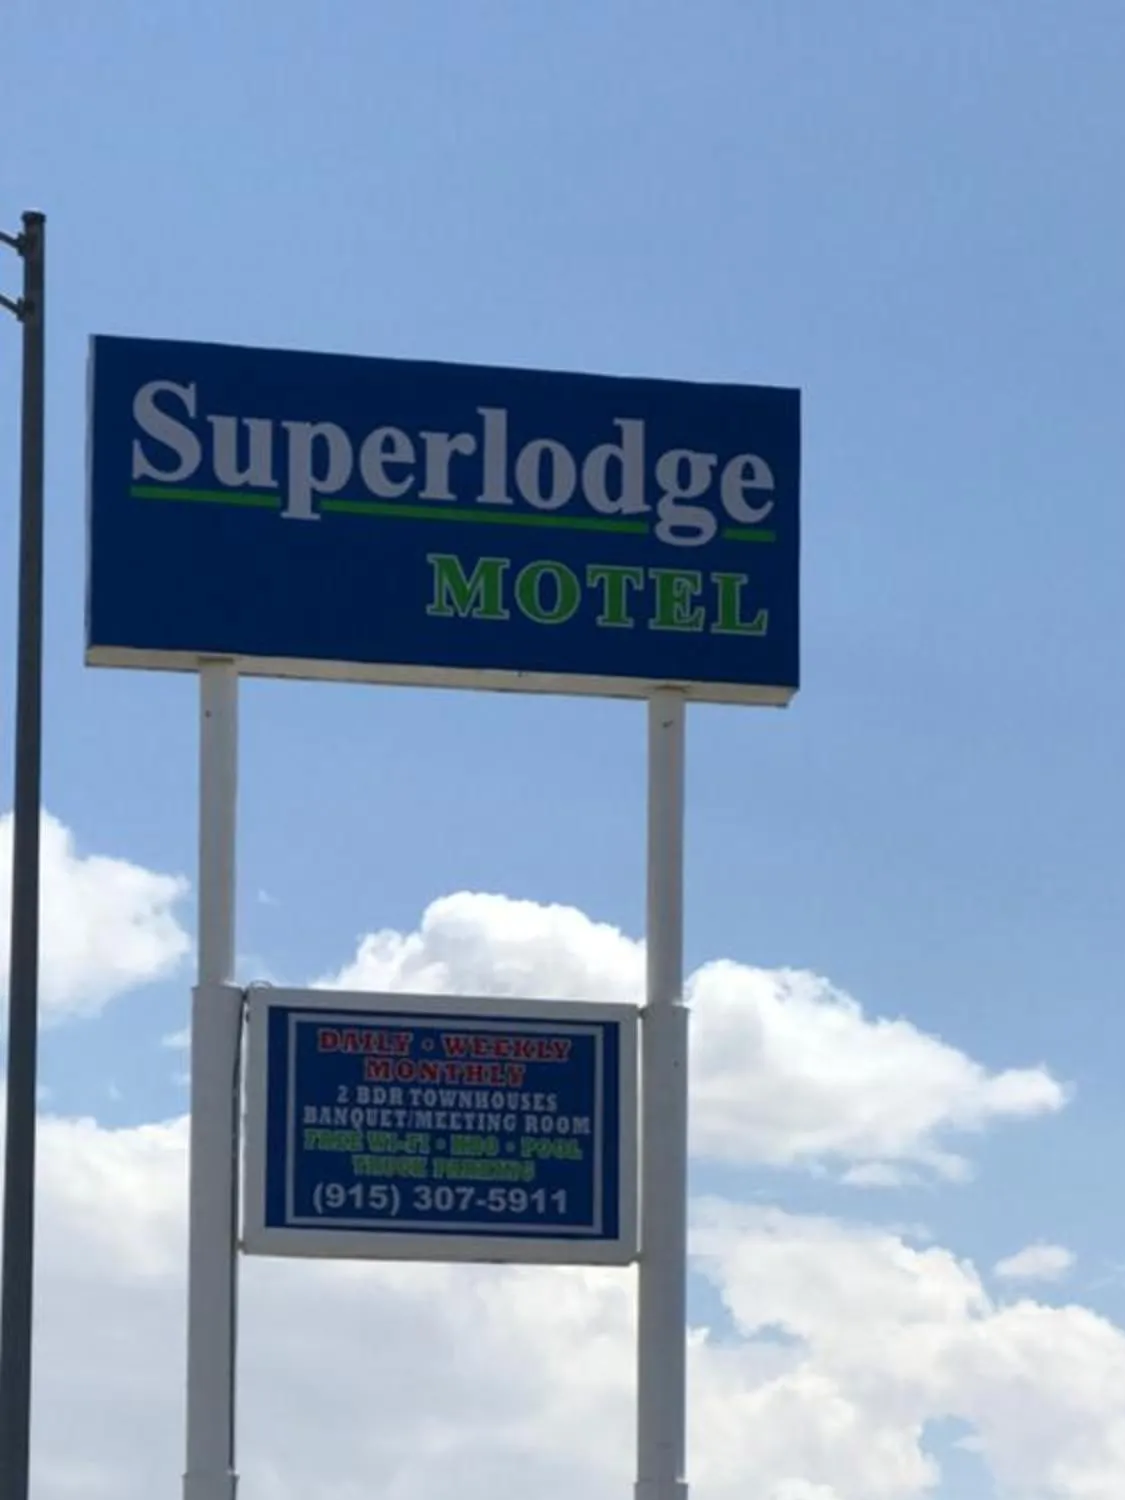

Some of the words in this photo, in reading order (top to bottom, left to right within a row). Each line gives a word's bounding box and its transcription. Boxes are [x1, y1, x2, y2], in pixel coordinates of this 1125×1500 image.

[131, 380, 776, 547] Superlodge
[426, 553, 770, 636] MOTEL
[317, 1027, 413, 1056] DAILY
[440, 1034, 572, 1063] WEEKLY
[364, 1056, 527, 1088] MONTHLY
[337, 1086, 349, 1103] 2
[409, 1088, 558, 1112] TOWNHOUSES
[303, 1106, 517, 1132] BANQUET/MEETING
[524, 1114, 592, 1135] ROOM
[304, 1128, 363, 1152] FREE
[521, 1136, 583, 1160] POOL
[312, 1182, 401, 1217] (915)
[412, 1185, 568, 1214] 307-5911
